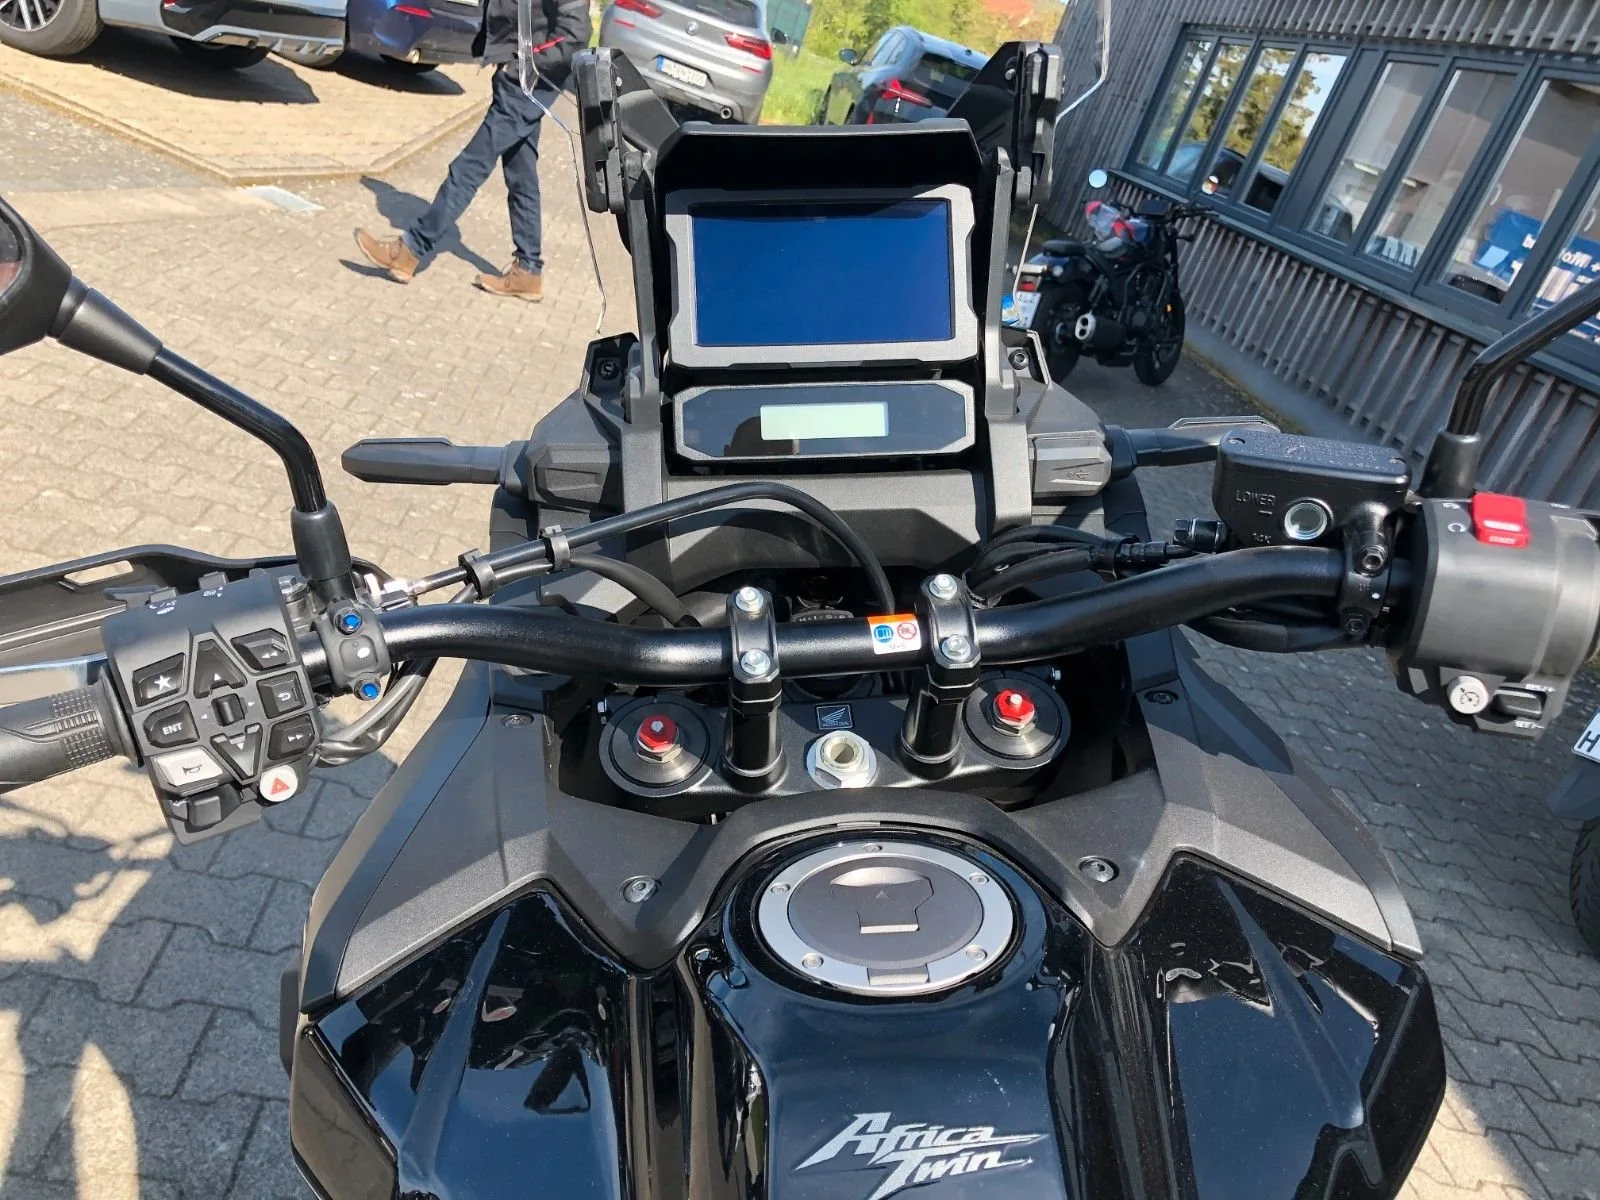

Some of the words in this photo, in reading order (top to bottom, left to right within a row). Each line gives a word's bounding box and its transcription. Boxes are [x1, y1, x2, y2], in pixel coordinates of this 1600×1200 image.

[162, 722, 182, 735] ENT
[794, 1111, 1049, 1171] Africa
[868, 1144, 1033, 1200] Twin
